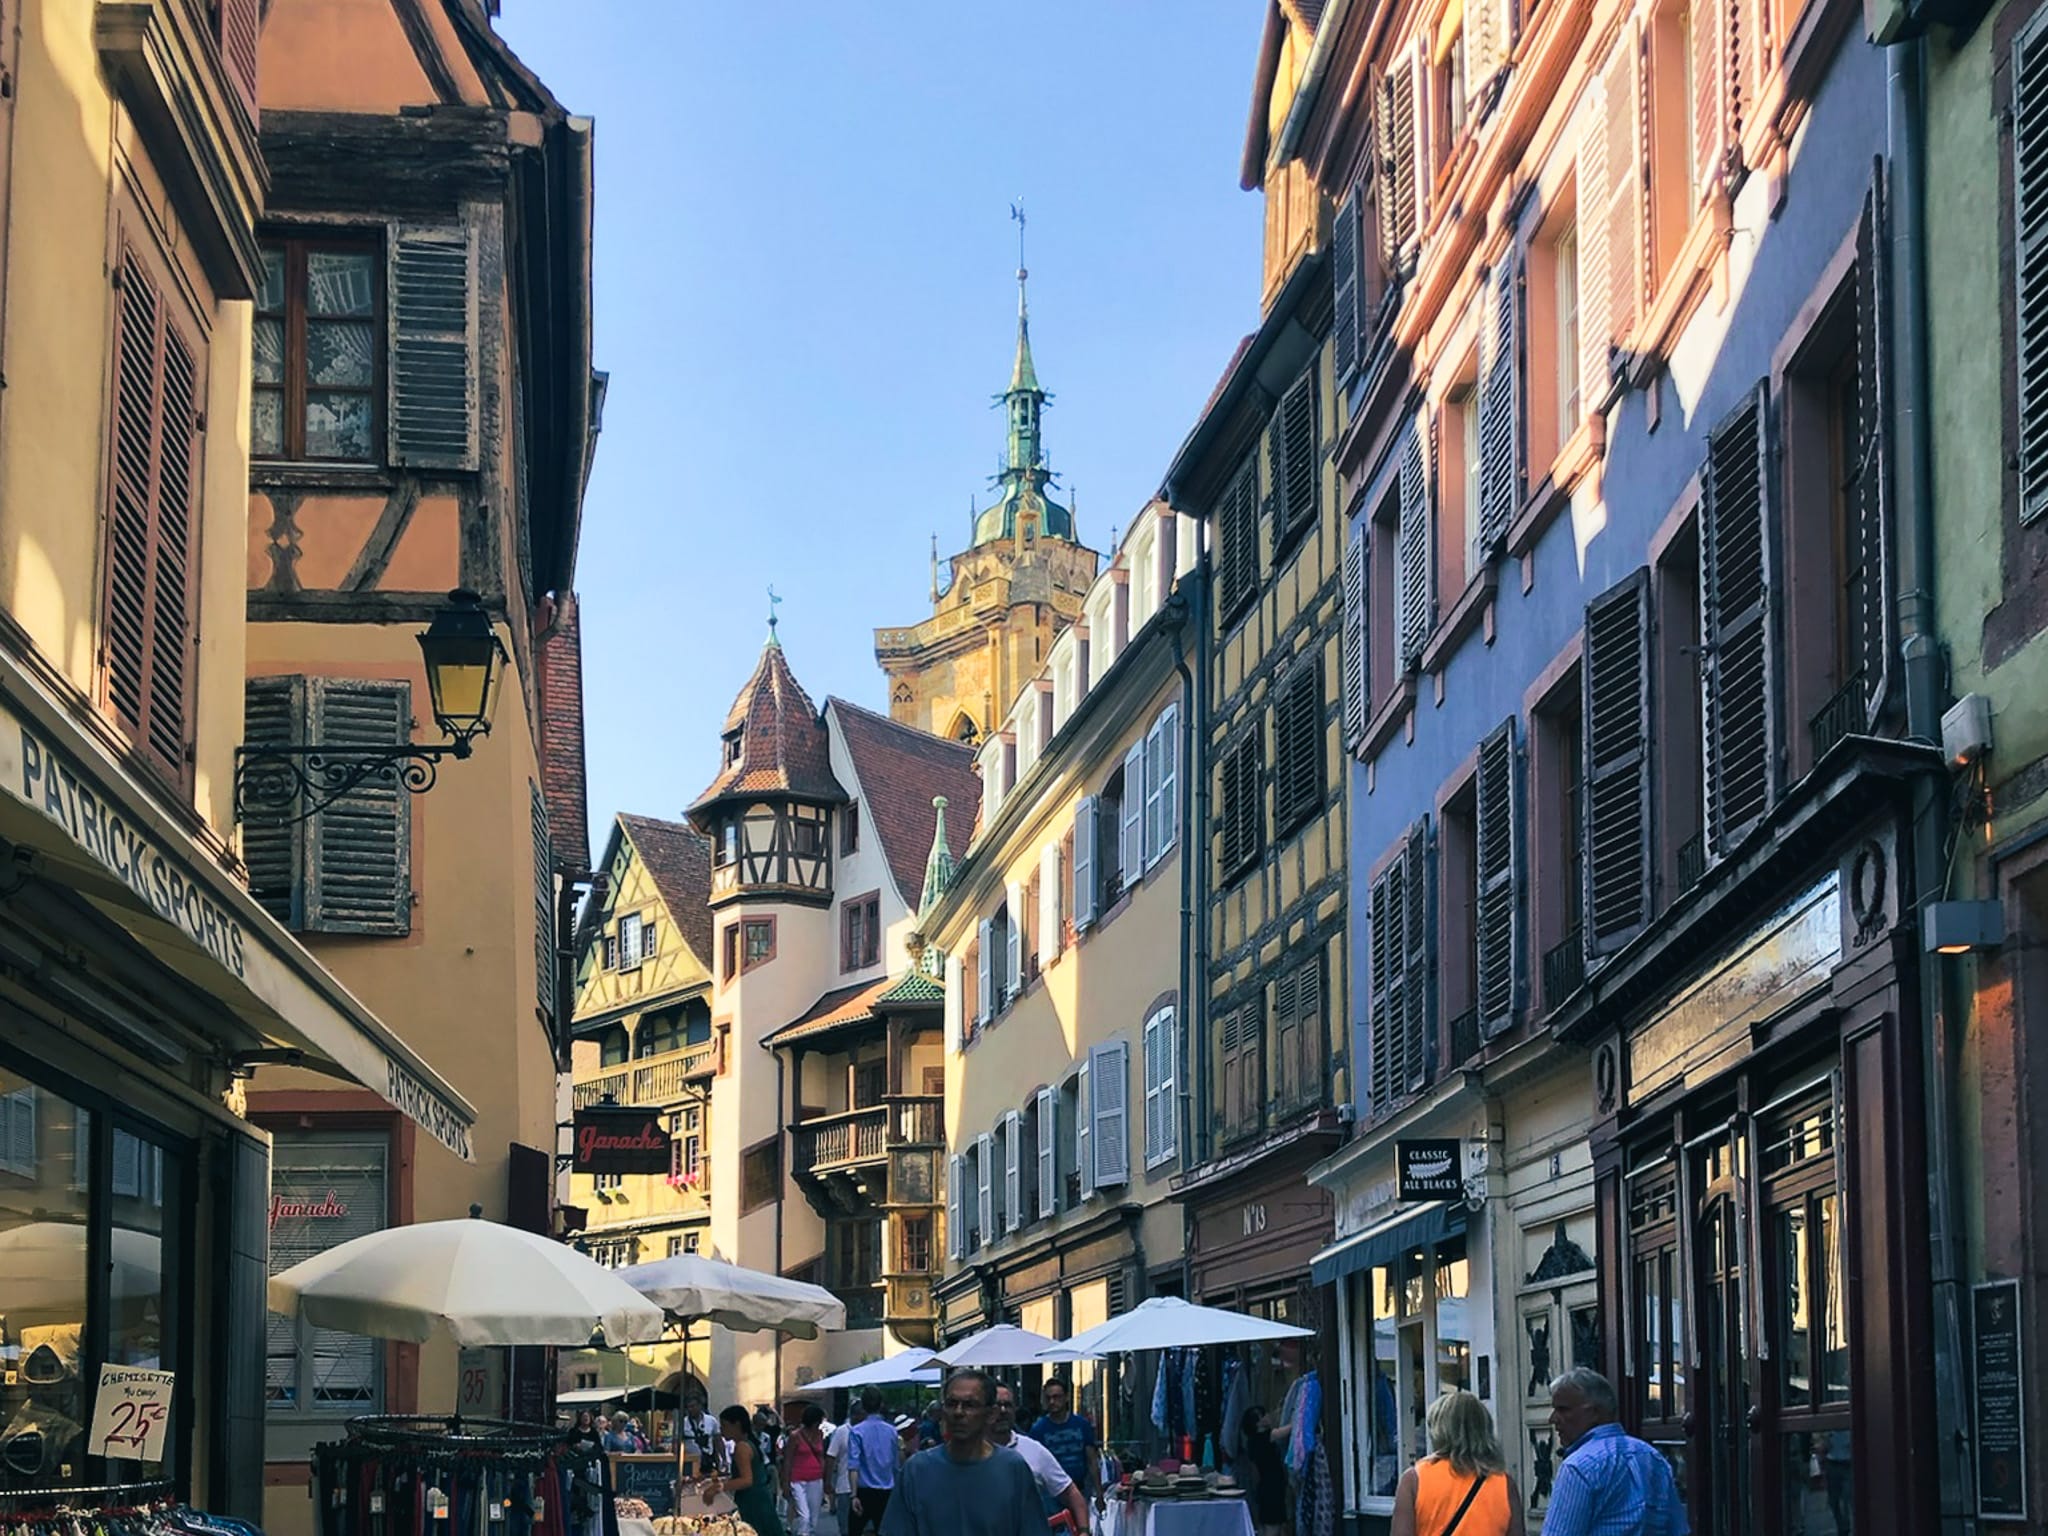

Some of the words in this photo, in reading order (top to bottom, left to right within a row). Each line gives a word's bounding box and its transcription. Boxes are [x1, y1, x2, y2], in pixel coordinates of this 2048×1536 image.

[20, 727, 149, 892] PATRICK
[151, 856, 244, 978] SPORTS
[387, 1058, 431, 1128] PATRICK
[432, 1100, 469, 1159] SPORTS
[1409, 1151, 1448, 1160] CLASSIC
[1404, 1181, 1420, 1189] ALL
[1423, 1180, 1457, 1189] BLACKS
[101, 1372, 176, 1387] CHEMISETTE
